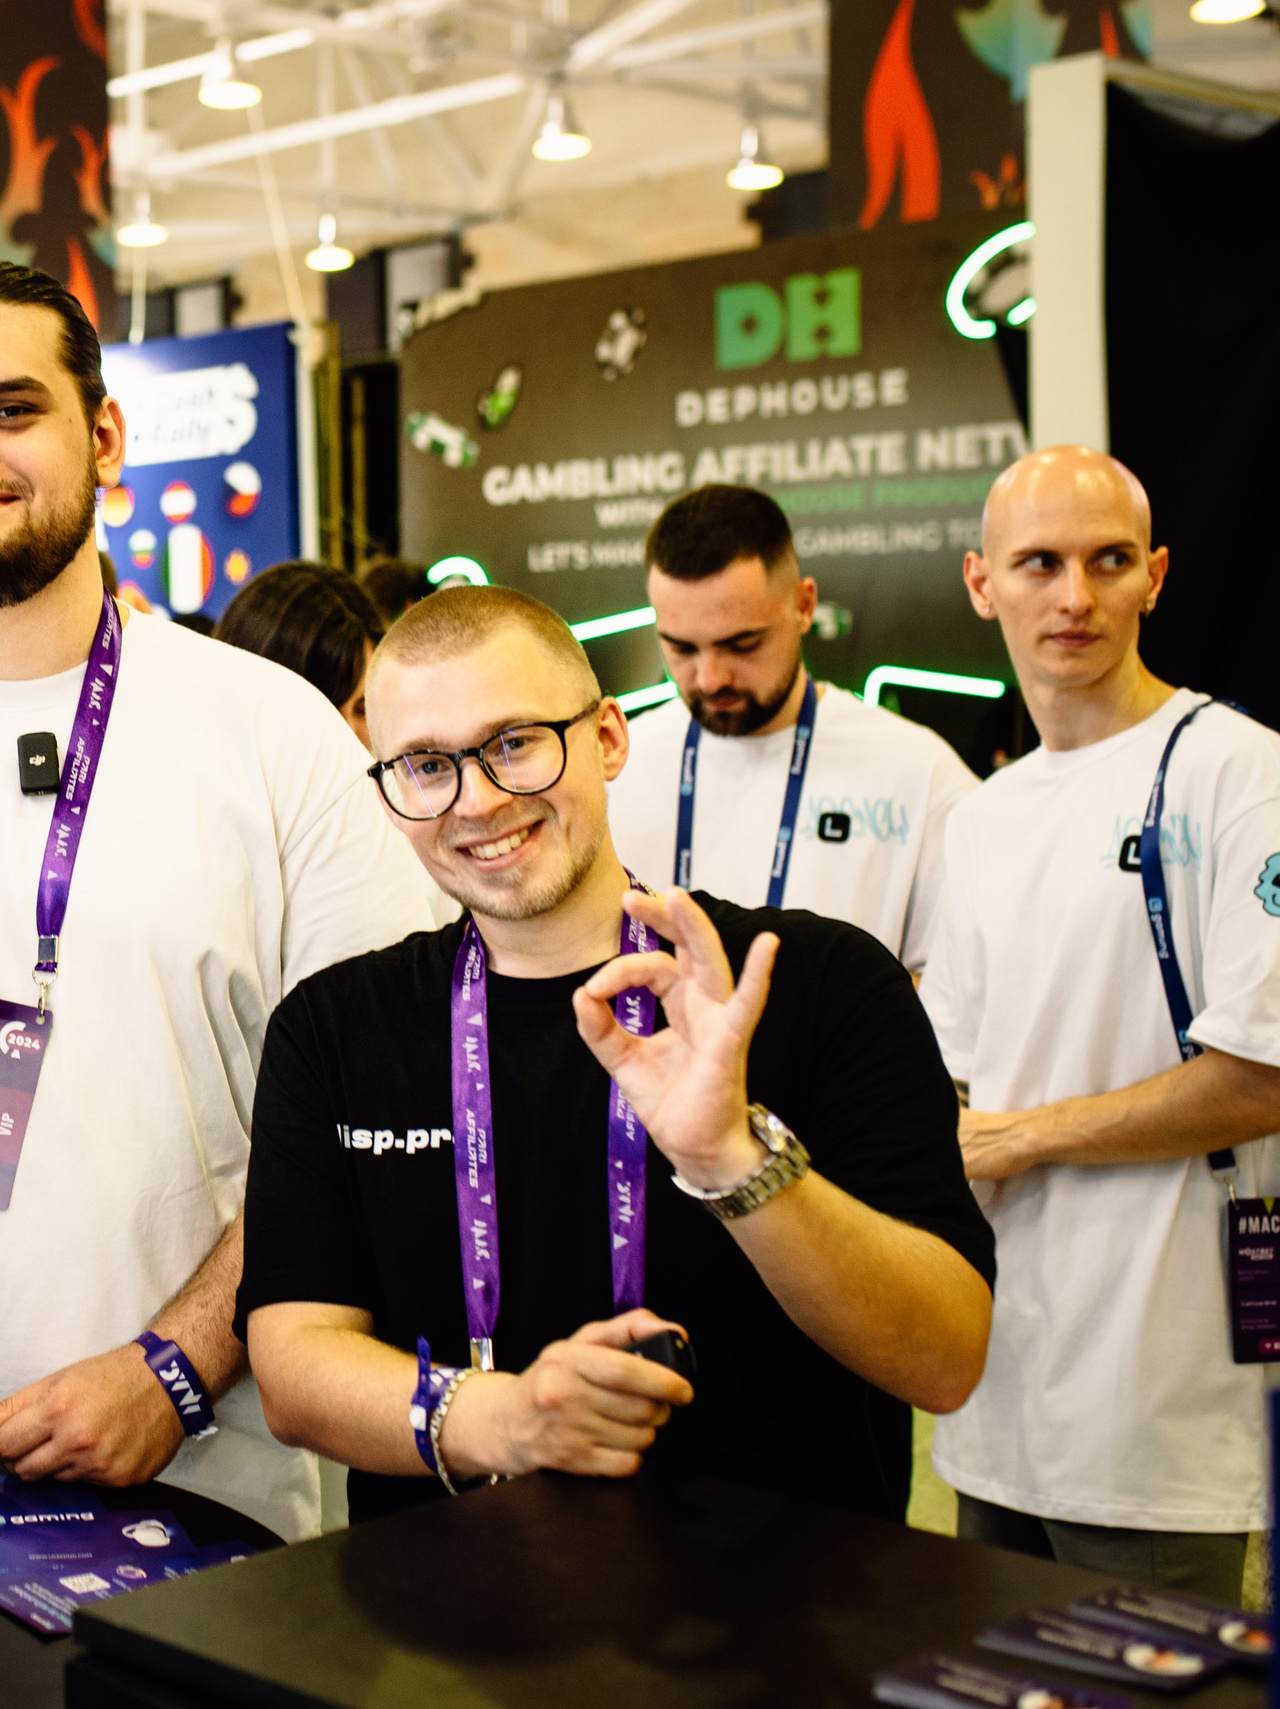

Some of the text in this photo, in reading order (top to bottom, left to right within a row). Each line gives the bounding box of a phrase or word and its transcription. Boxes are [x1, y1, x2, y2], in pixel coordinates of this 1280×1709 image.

[715, 266, 862, 371] DH
[675, 367, 908, 427] DEPHOUSE
[482, 451, 685, 507] GAMBLING
[690, 431, 907, 489] AFFILIATE
[65, 736, 86, 801] AFFILIATES
[7, 1033, 41, 1051] 2024
[336, 1123, 456, 1155] isp.pr
[466, 1108, 479, 1189] AFFILIATES
[477, 1127, 488, 1164] PARI
[10, 1511, 95, 1525] gaming
